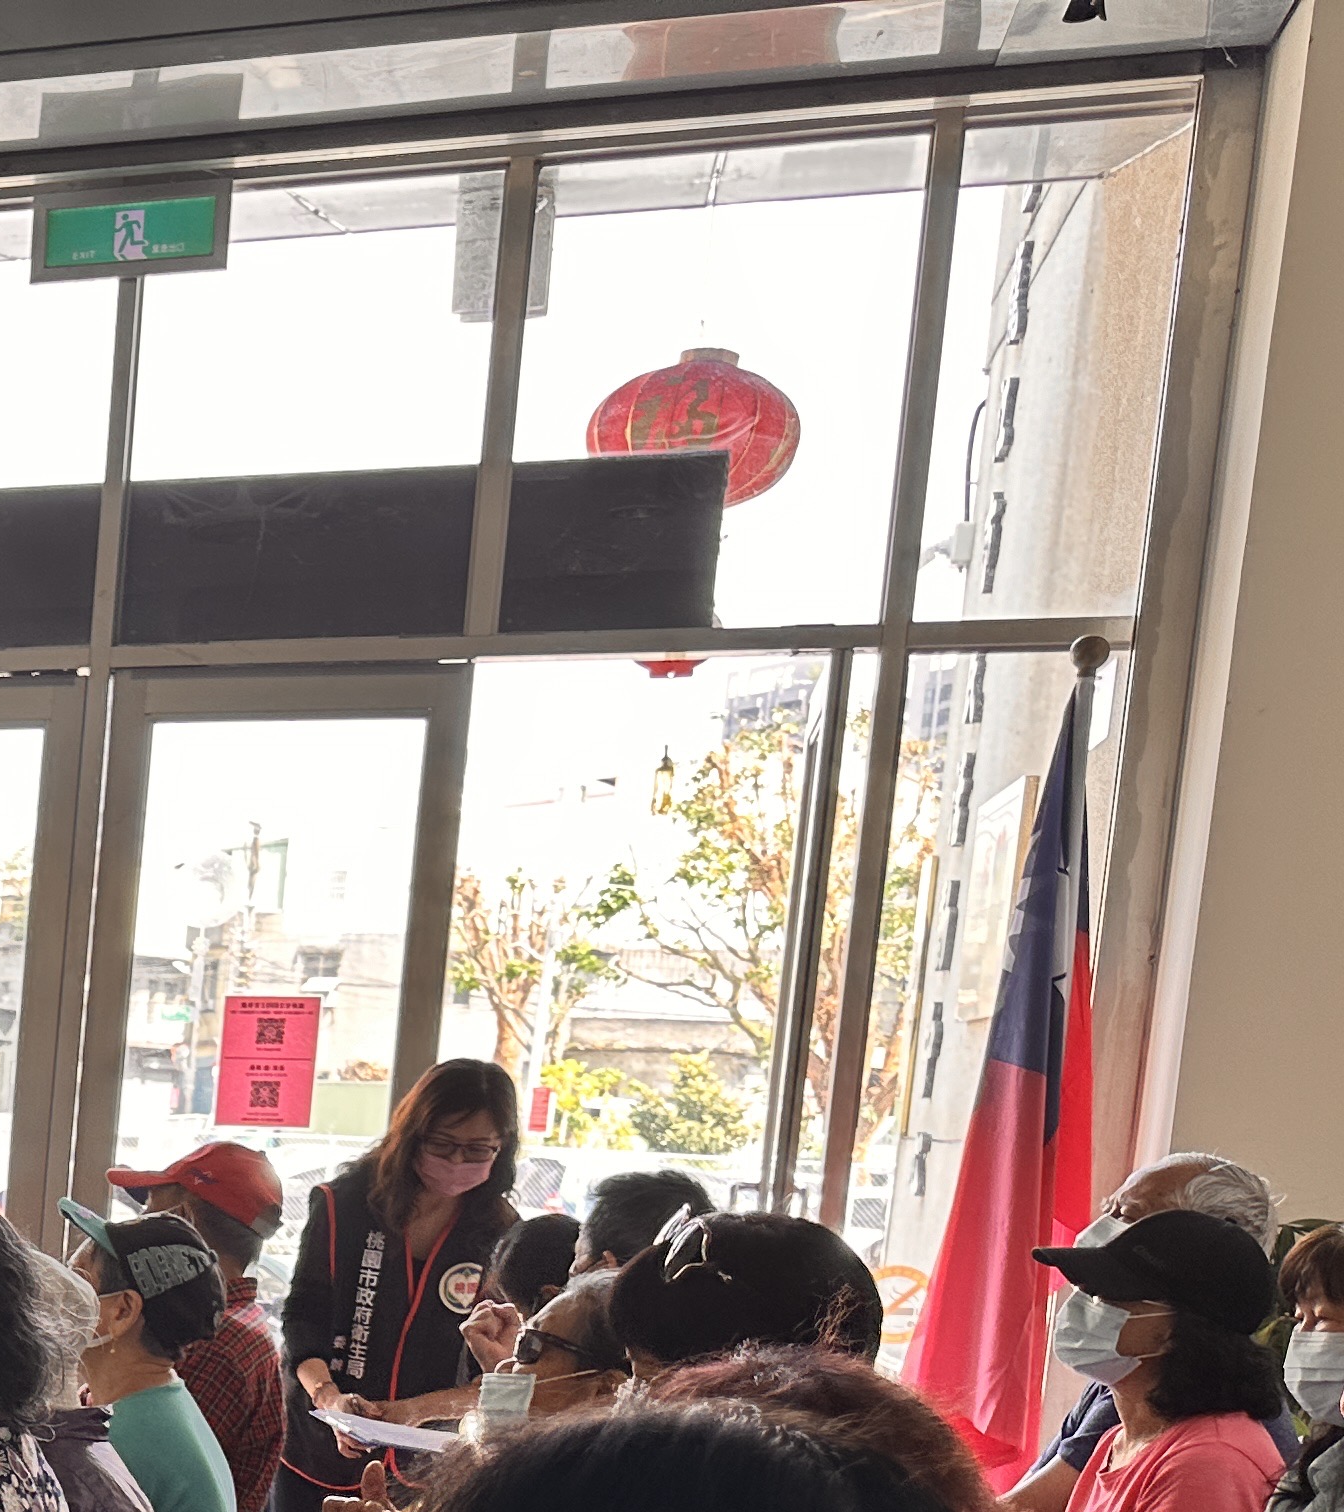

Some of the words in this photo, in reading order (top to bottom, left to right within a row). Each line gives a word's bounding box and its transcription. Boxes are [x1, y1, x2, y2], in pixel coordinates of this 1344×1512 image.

[346, 1230, 385, 1379] 桃園市政府衛生局
